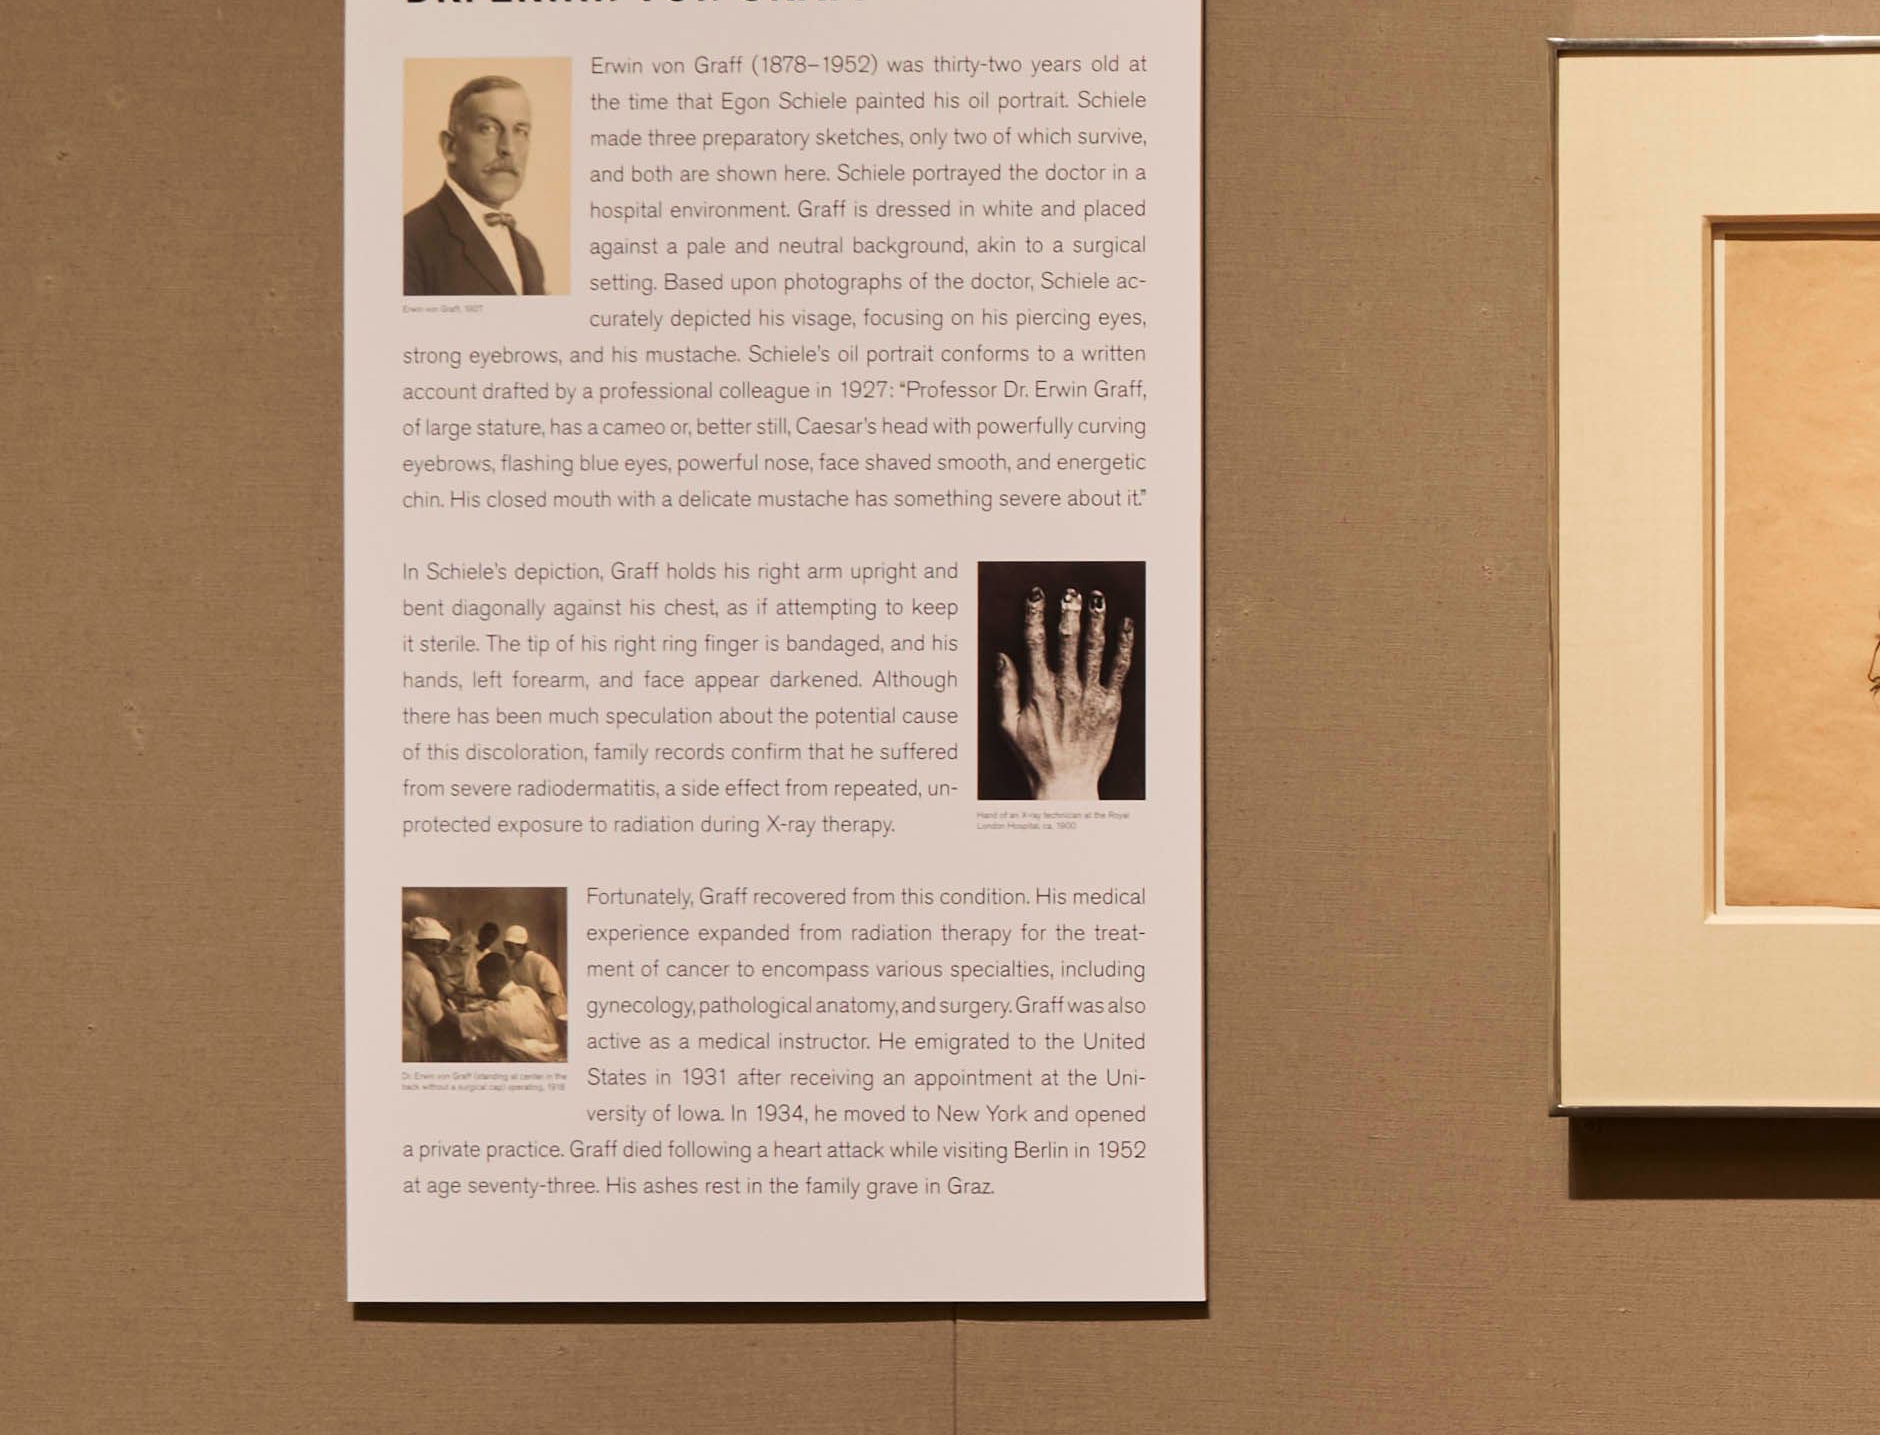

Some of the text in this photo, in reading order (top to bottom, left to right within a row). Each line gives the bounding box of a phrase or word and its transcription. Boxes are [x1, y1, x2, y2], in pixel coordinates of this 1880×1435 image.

[591, 56, 644, 75] Erwin
[651, 60, 686, 75] von
[693, 54, 744, 75] Graff
[886, 59, 924, 74] was
[932, 55, 1023, 79] thirty-two
[1030, 58, 1082, 78] years
[1091, 53, 1119, 73] old
[1128, 54, 1148, 73] at
[589, 89, 1147, 116] the time that Egon Schiele painted his oil portrait. Schiele
[589, 198, 1146, 224] hospital environment. Graff is dressed in white and placed
[402, 346, 462, 370] strong
[468, 345, 563, 370] eyebrows,
[569, 345, 604, 364] and
[611, 345, 638, 364] his
[645, 344, 742, 364] mustache.
[837, 344, 859, 363] oil
[866, 344, 935, 368] portrait
[940, 343, 1030, 363] conforms
[1036, 344, 1056, 362] to
[1063, 348, 1075, 362] a
[1081, 344, 1146, 362] written
[403, 562, 419, 581] In
[513, 562, 604, 586] depiction,
[610, 560, 660, 581] Graff
[666, 561, 717, 580] holds
[723, 561, 751, 580] his
[757, 561, 801, 586] right
[807, 566, 843, 580] arm
[850, 561, 918, 585] upright
[923, 561, 959, 580] and
[402, 669, 958, 694] hands, left forearm, and face appear darkened. Although
[402, 814, 896, 839] protected exposure to radiation during X-ray therapy.
[586, 886, 1146, 911] Fortunately, Graff recovered from this condition. His medical
[586, 1031, 1146, 1056] active as a medical instructor. He emigrated to the United
[586, 1067, 648, 1086] States
[655, 1068, 672, 1086] in
[682, 1066, 726, 1087] 1931
[737, 1067, 783, 1087] after
[789, 1068, 874, 1092] receiving
[882, 1072, 906, 1086] an
[913, 1069, 1033, 1092] appointment
[1040, 1069, 1060, 1087] at
[1066, 1068, 1098, 1087] the
[1106, 1068, 1147, 1087] Uni-
